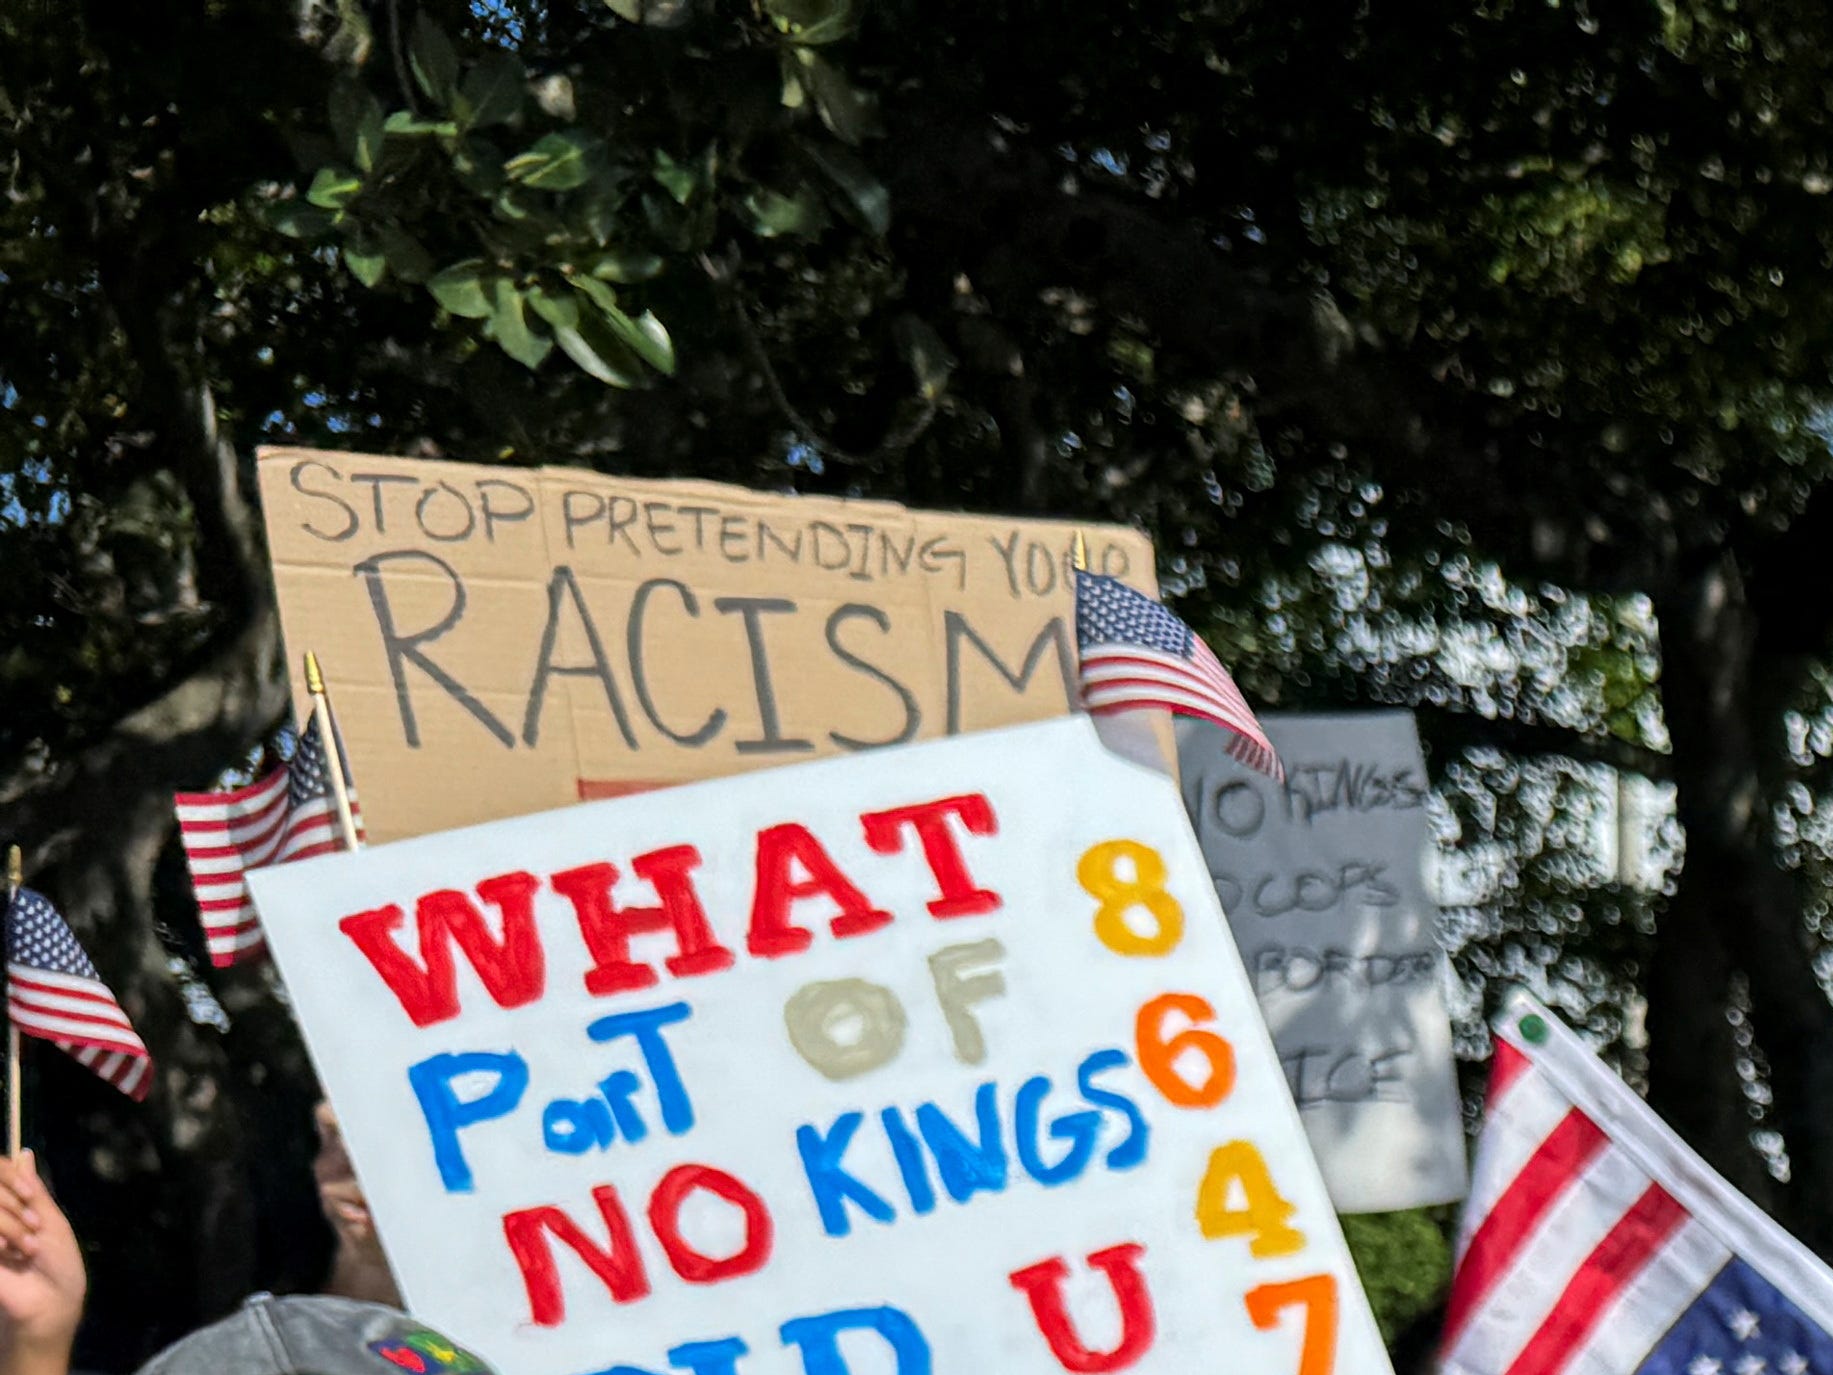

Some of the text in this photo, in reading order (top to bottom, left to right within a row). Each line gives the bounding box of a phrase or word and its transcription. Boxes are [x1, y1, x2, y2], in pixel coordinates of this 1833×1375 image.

[289, 459, 535, 543] STOP
[564, 490, 967, 591] PRETENDING
[353, 549, 1085, 753] RACISM
[339, 792, 1002, 1029] WHAT
[783, 938, 1009, 1082] OF
[502, 1048, 1151, 1330] NO KINGS
